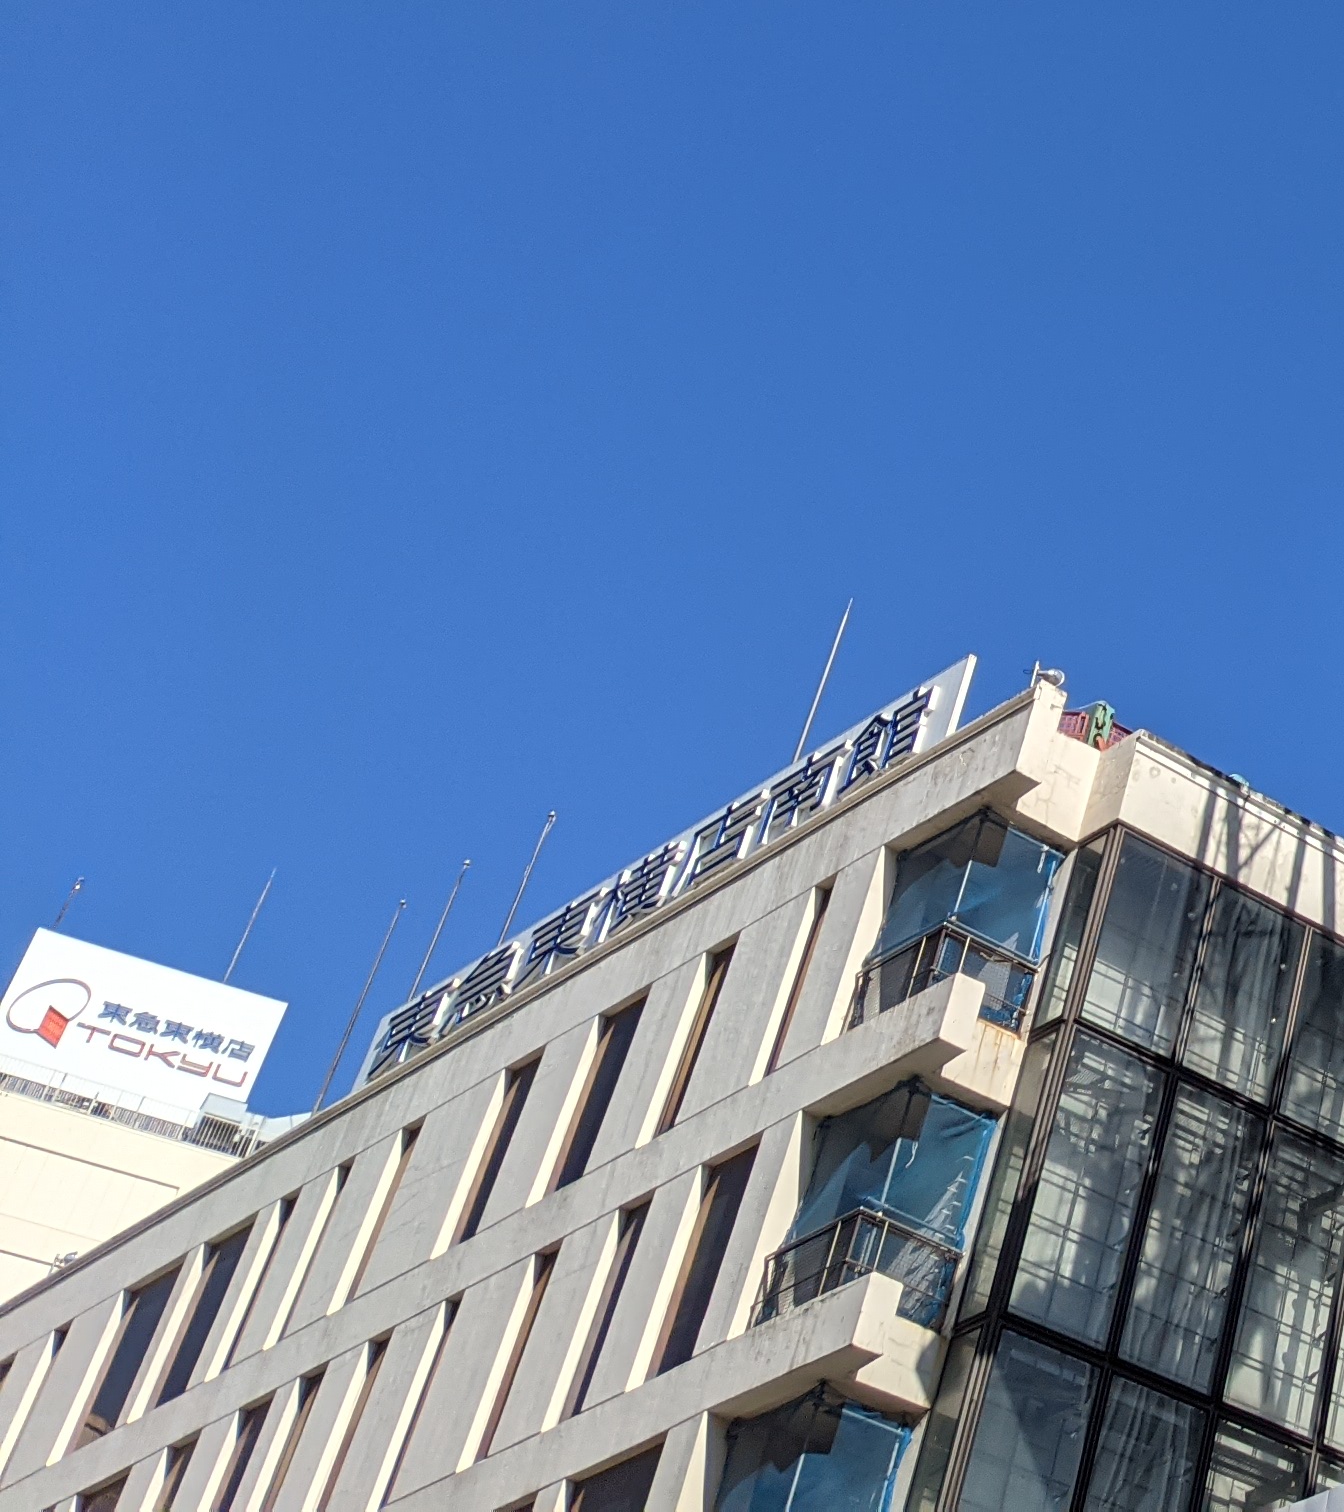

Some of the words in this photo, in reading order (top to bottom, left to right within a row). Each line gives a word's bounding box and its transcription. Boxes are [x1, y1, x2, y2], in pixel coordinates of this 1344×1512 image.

[75, 1021, 249, 1088] TOKYU
[97, 1000, 256, 1063] 東急東横店
